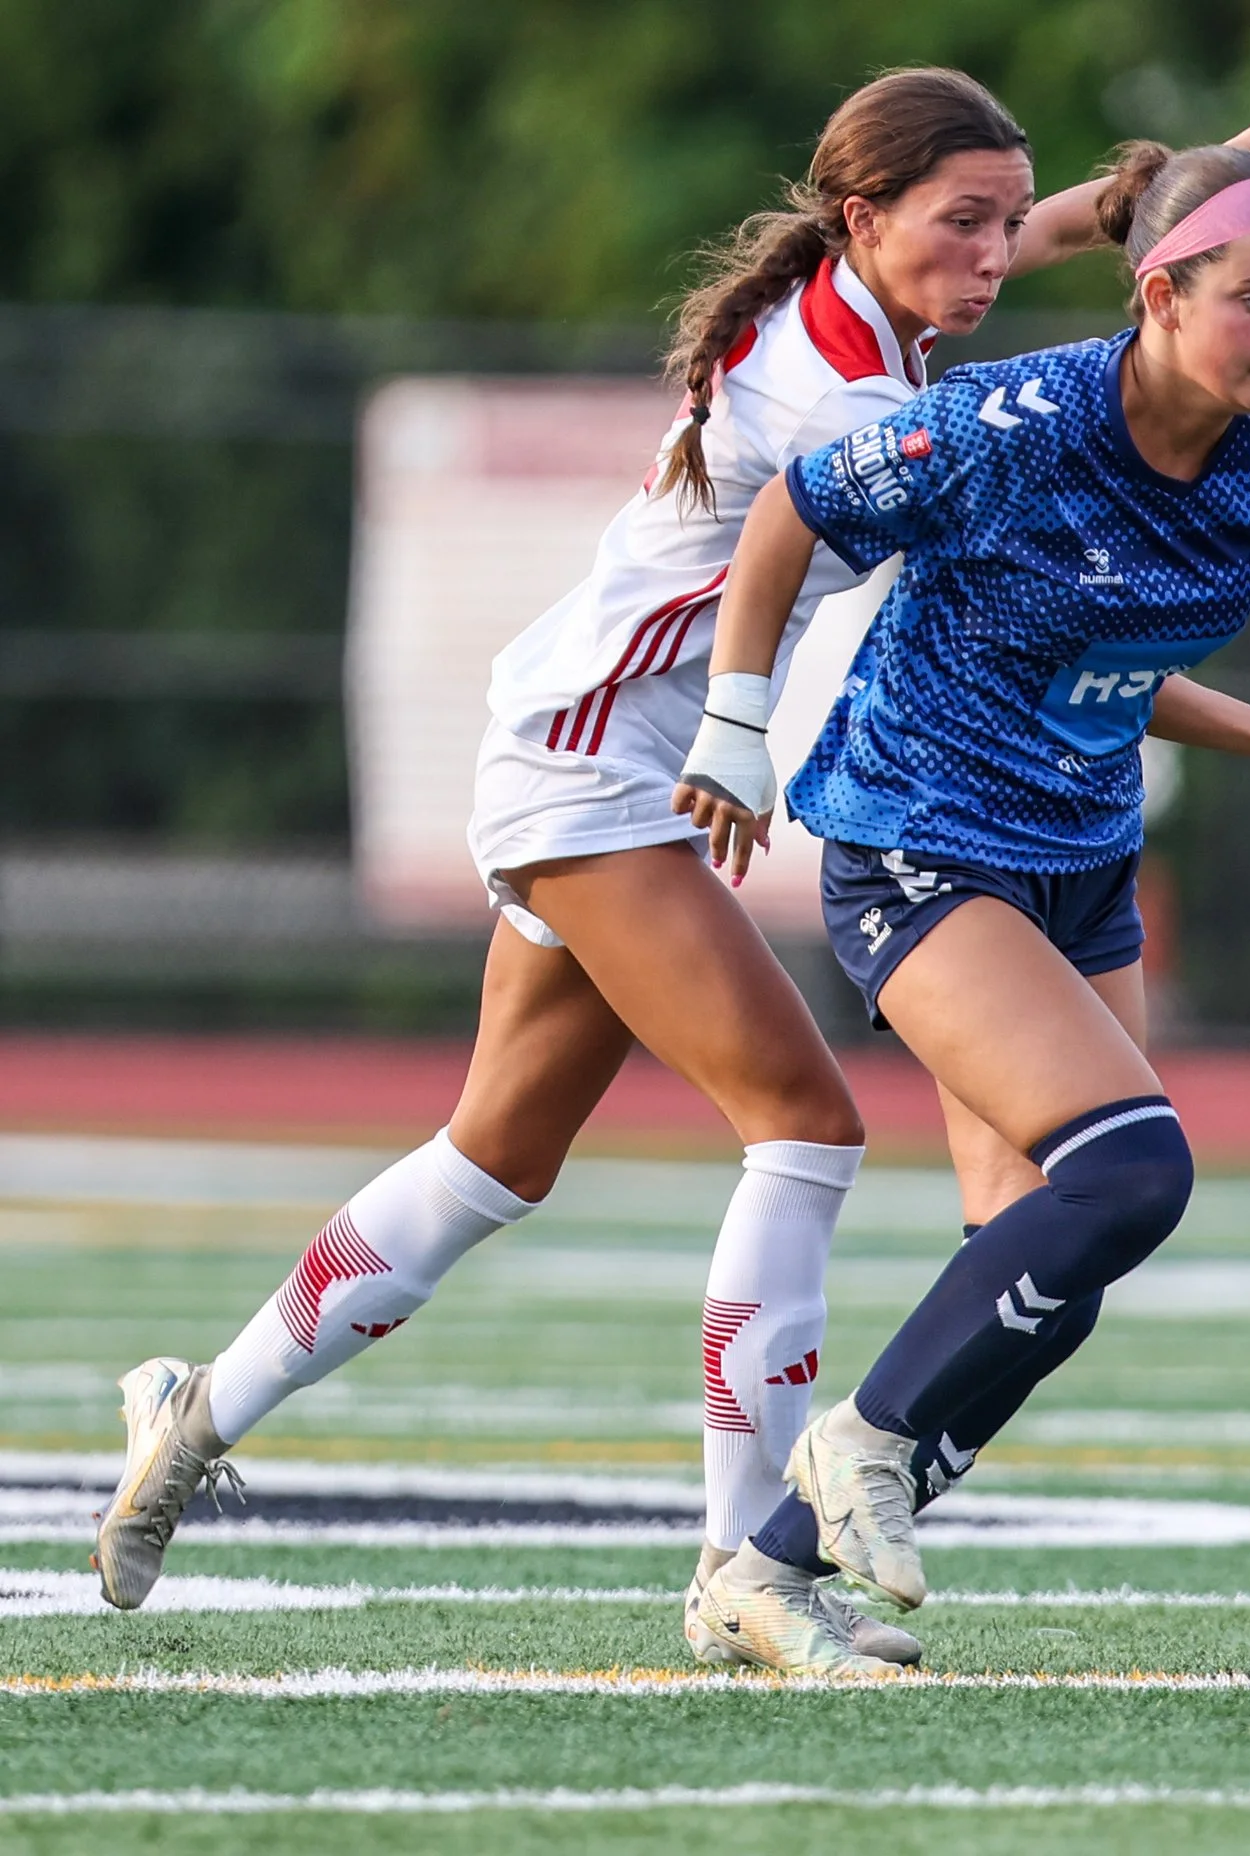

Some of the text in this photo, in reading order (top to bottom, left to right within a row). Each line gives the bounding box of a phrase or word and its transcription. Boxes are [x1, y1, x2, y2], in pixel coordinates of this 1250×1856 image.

[851, 423, 908, 511] CHONG
[883, 425, 914, 482] HOUSE OF
[838, 479, 861, 506] 1969
[1079, 571, 1124, 585] hummel
[867, 921, 893, 956] hummel
